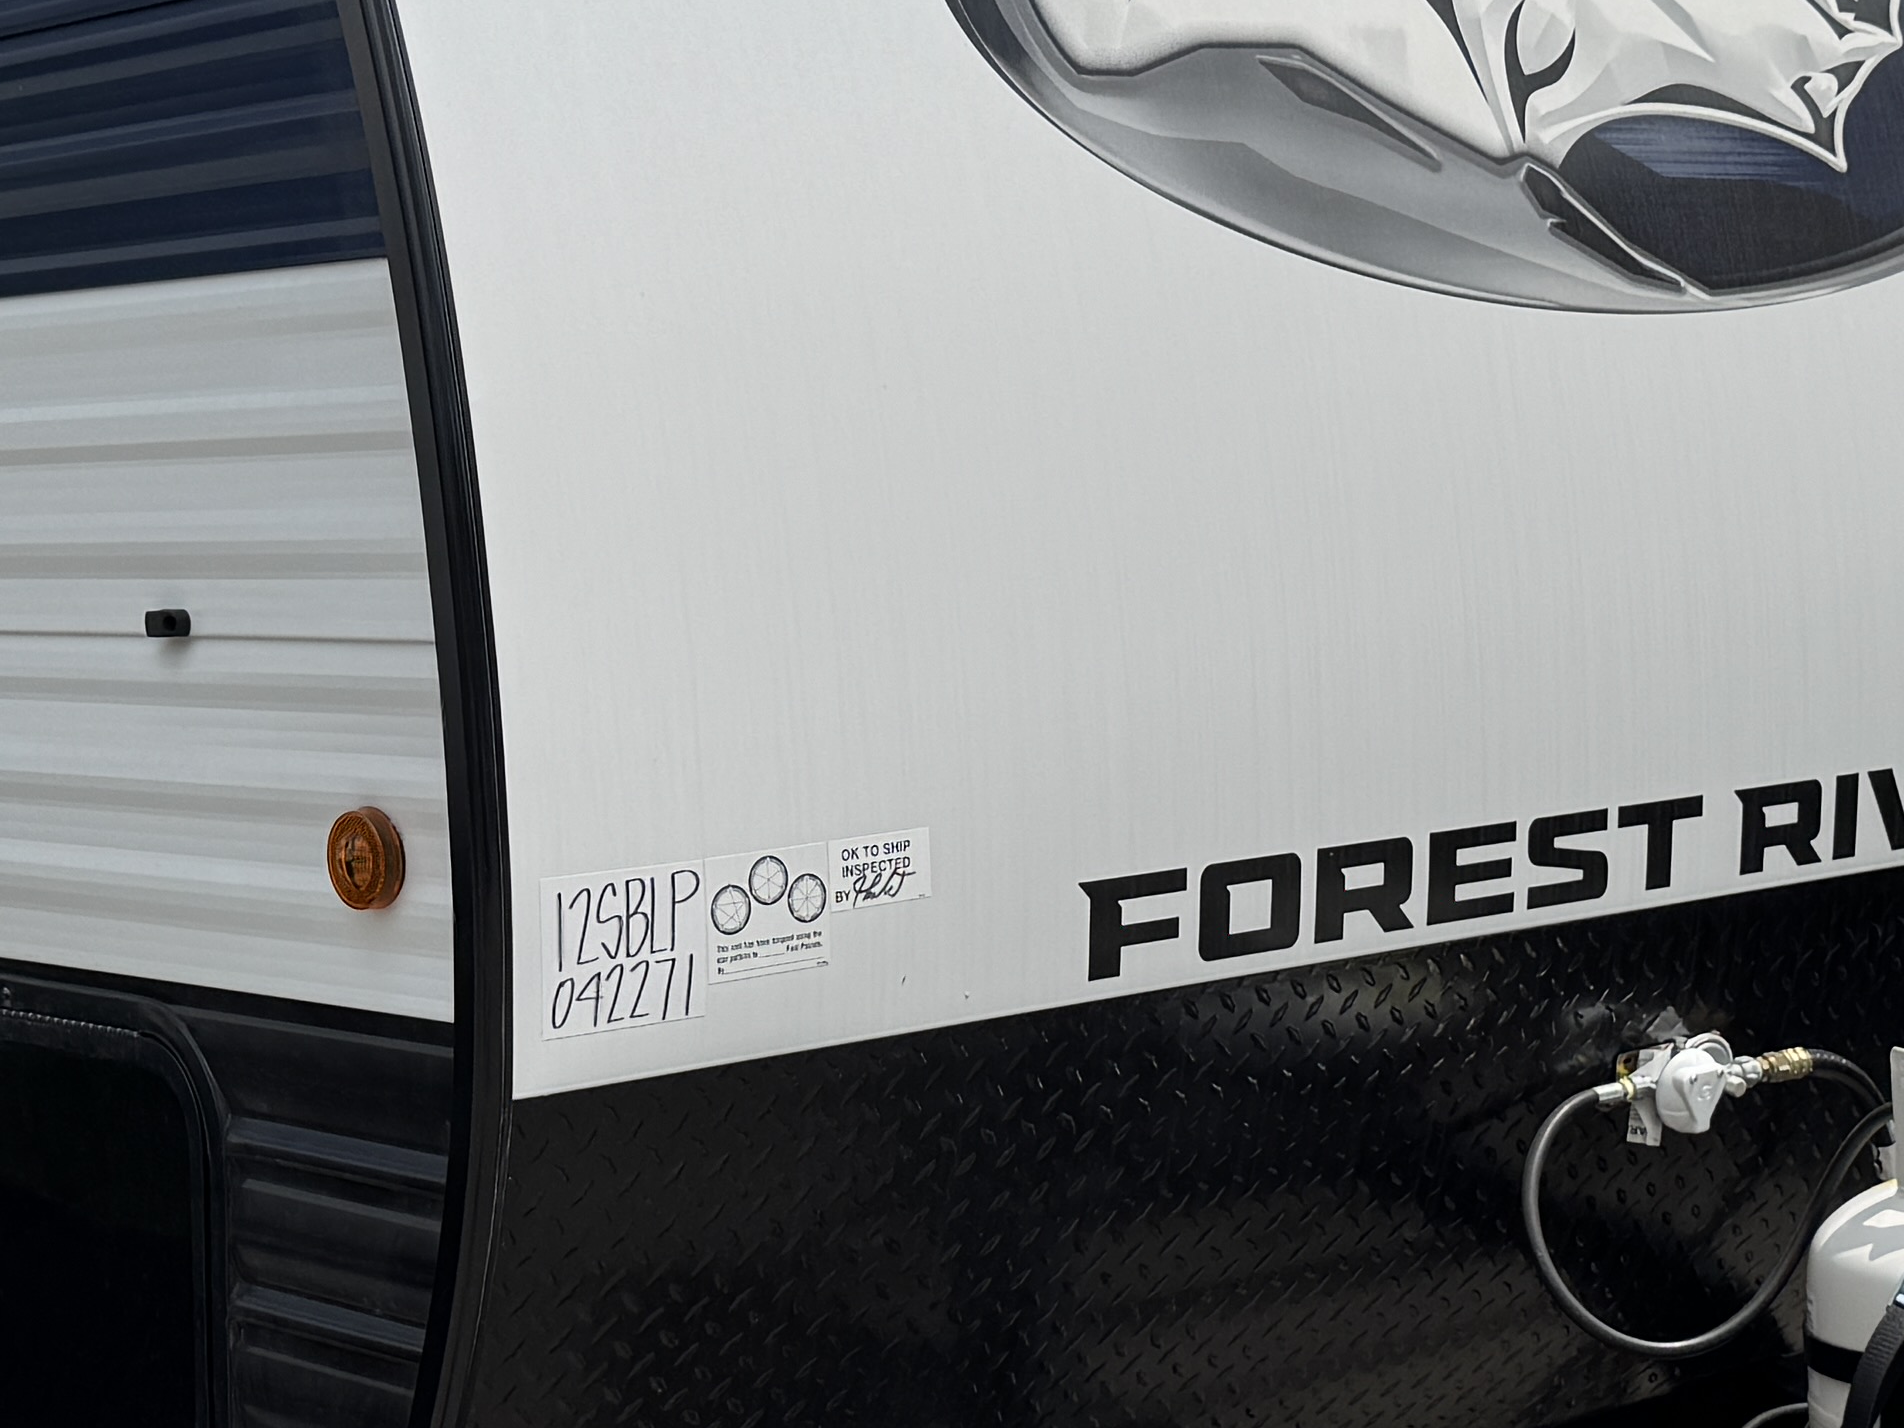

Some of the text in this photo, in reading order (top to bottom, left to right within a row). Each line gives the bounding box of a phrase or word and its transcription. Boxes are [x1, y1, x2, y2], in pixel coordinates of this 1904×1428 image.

[841, 840, 911, 861] OK TO SHIP
[842, 857, 911, 878] INSPECTED
[835, 890, 851, 903] BY
[1078, 794, 1703, 981] FOREST
[552, 953, 694, 1030] 042271
